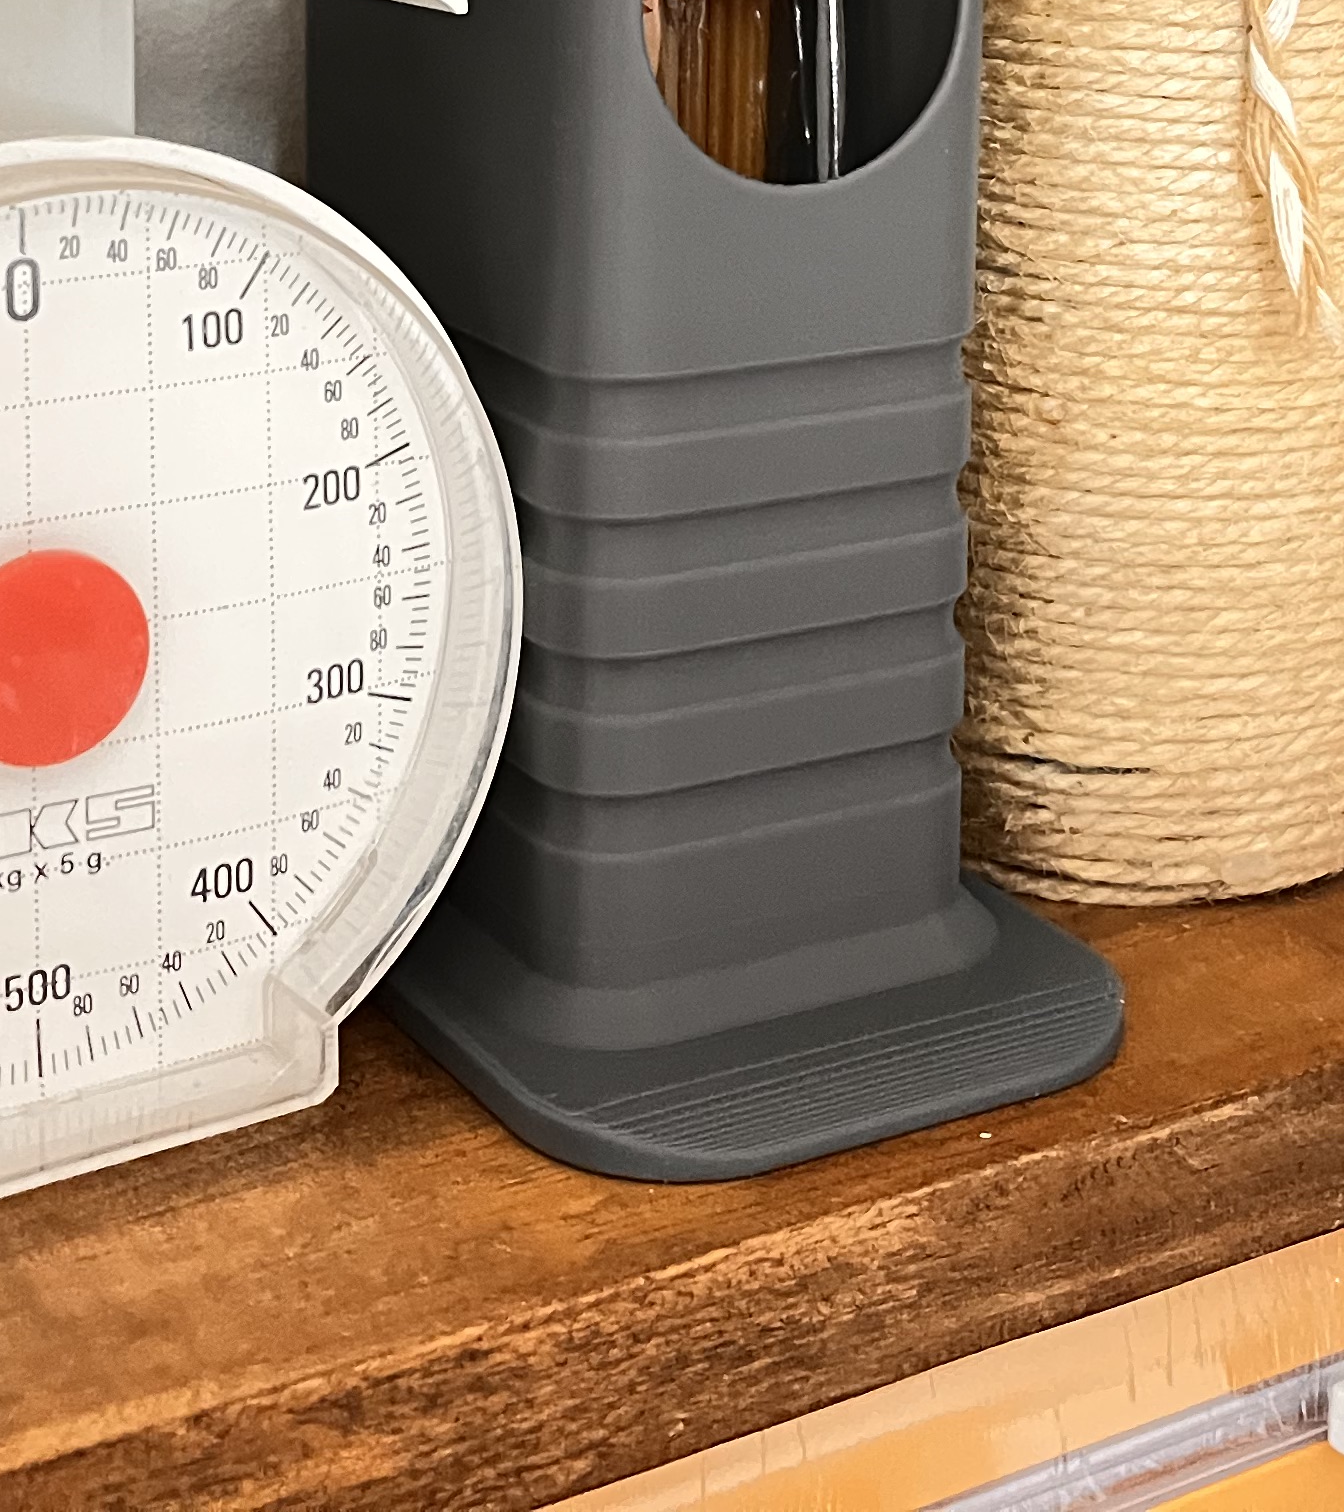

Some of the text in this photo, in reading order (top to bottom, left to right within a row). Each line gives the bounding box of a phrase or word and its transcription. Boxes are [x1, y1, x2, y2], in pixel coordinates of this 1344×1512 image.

[59, 235, 80, 258] 20
[106, 239, 128, 262] 40
[156, 249, 178, 271] 60
[5, 257, 41, 322] 0
[198, 266, 218, 289] 80
[181, 308, 244, 352] 100
[270, 314, 290, 337] 20
[300, 348, 320, 370] 40
[324, 381, 342, 403] 60
[340, 417, 360, 440] 80
[302, 465, 361, 511] 200
[368, 502, 387, 526] 20
[372, 544, 391, 568] 40
[373, 584, 391, 607] 60
[369, 628, 388, 651] 80
[306, 659, 365, 706] 300
[344, 722, 362, 746] 20
[322, 769, 342, 791] 40
[301, 809, 320, 832] 60
[60, 851, 74, 874] 5
[87, 852, 102, 875] g
[269, 853, 289, 877] 80
[191, 858, 254, 903] 400
[205, 920, 226, 944] 20
[161, 951, 183, 973] 40
[5, 964, 72, 1013] 500
[119, 973, 140, 998] 60
[72, 993, 94, 1017] 80
